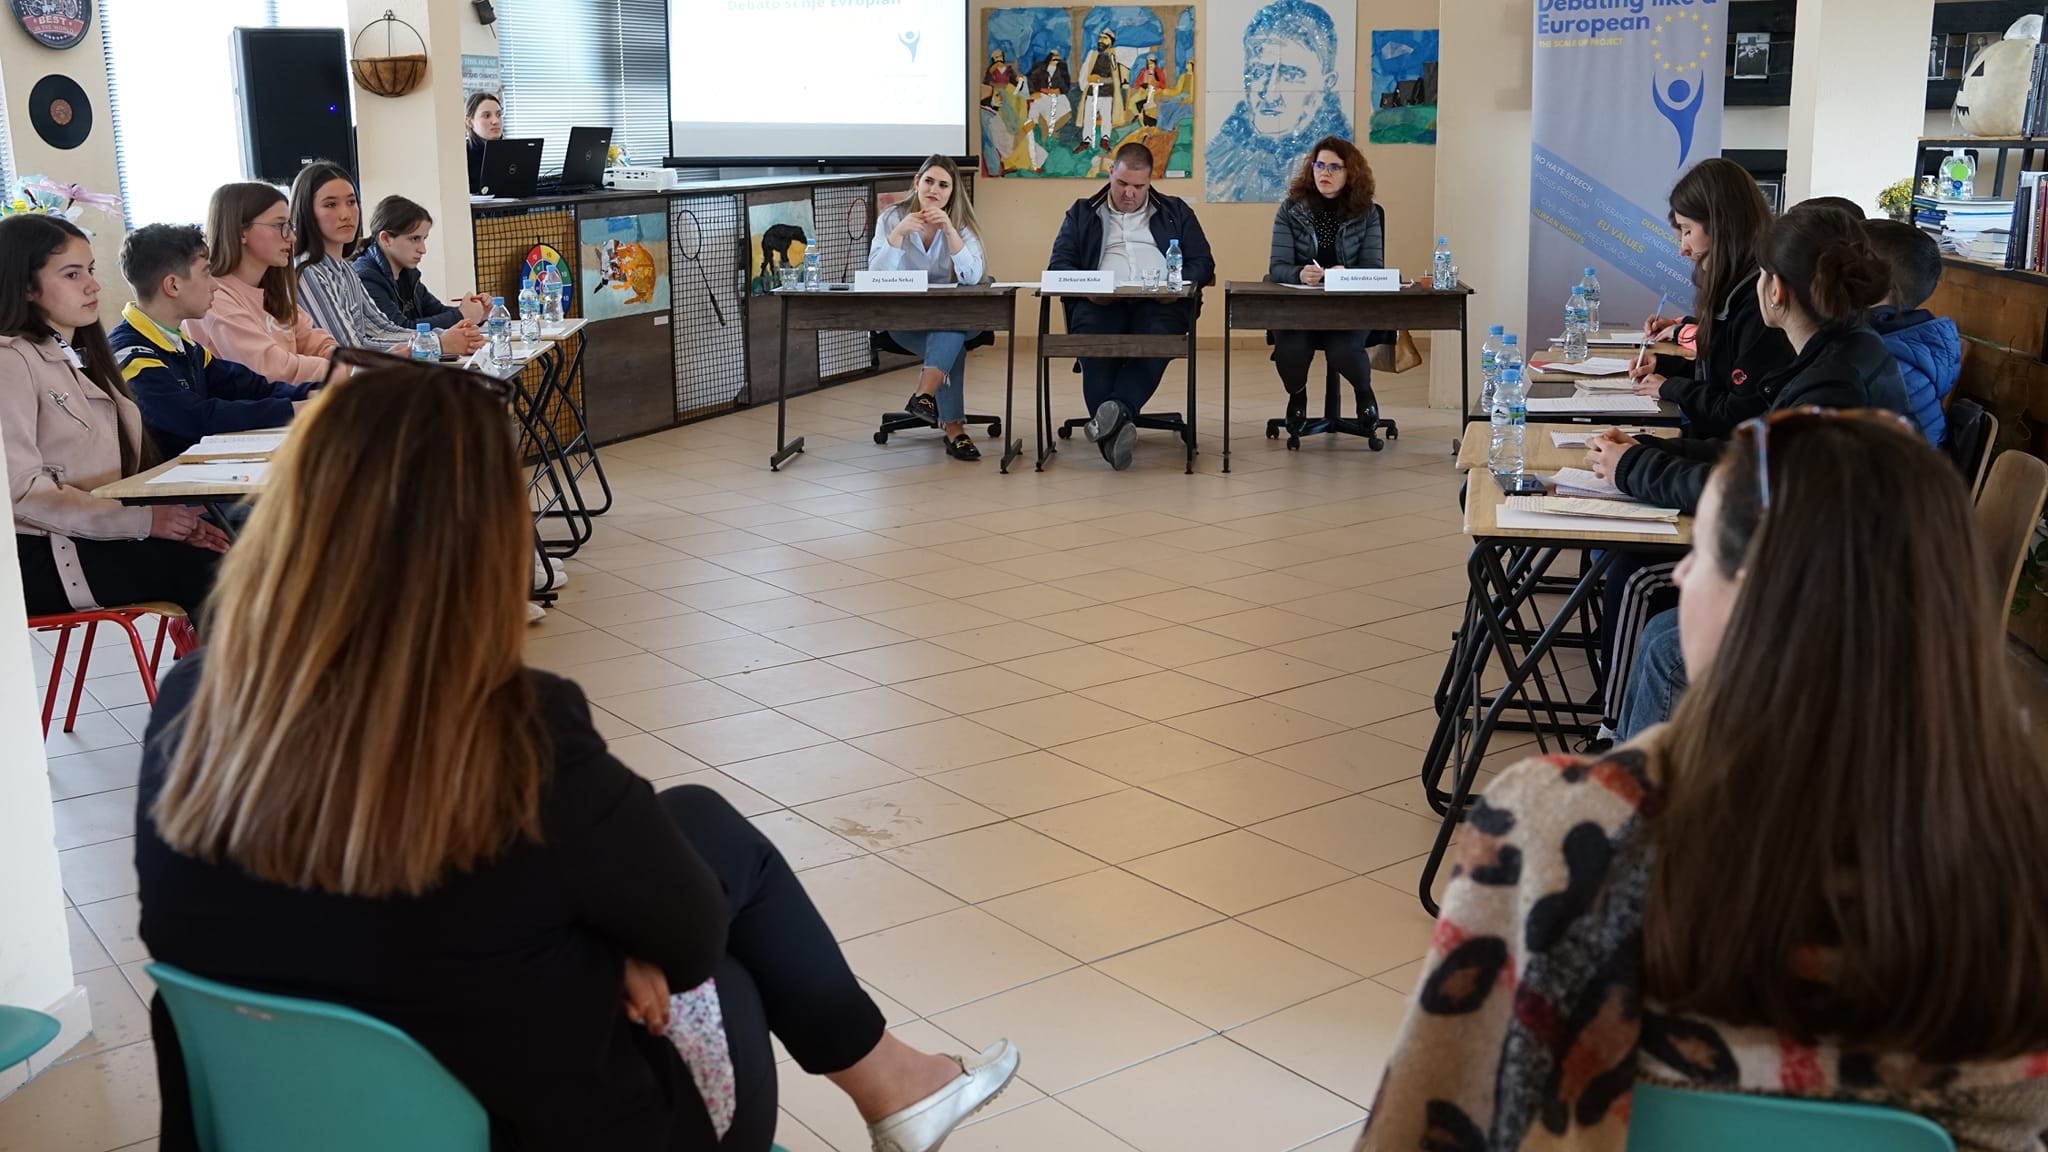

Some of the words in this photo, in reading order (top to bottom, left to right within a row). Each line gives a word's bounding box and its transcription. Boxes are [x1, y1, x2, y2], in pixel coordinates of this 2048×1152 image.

[1538, 0, 1644, 13] Debating
[38, 15, 67, 25] BEST
[1538, 14, 1650, 38] European
[1538, 40, 1551, 48] THE
[1553, 39, 1577, 48] SCALE
[1589, 37, 1624, 47] PROJECT
[1535, 153, 1546, 164] NO
[1545, 161, 1566, 177] HATE
[1565, 172, 1593, 193] SPEECH
[1594, 198, 1634, 228] TOLERANCE
[1559, 222, 1586, 245] RIGHTS
[1597, 218, 1610, 232] EU
[1610, 227, 1646, 255] VALUES
[1641, 218, 1680, 248] DEMOCRA
[1641, 232, 1671, 254] GENDER
[1629, 258, 1657, 280] SPEECH
[1655, 260, 1693, 288] DIVERSITY
